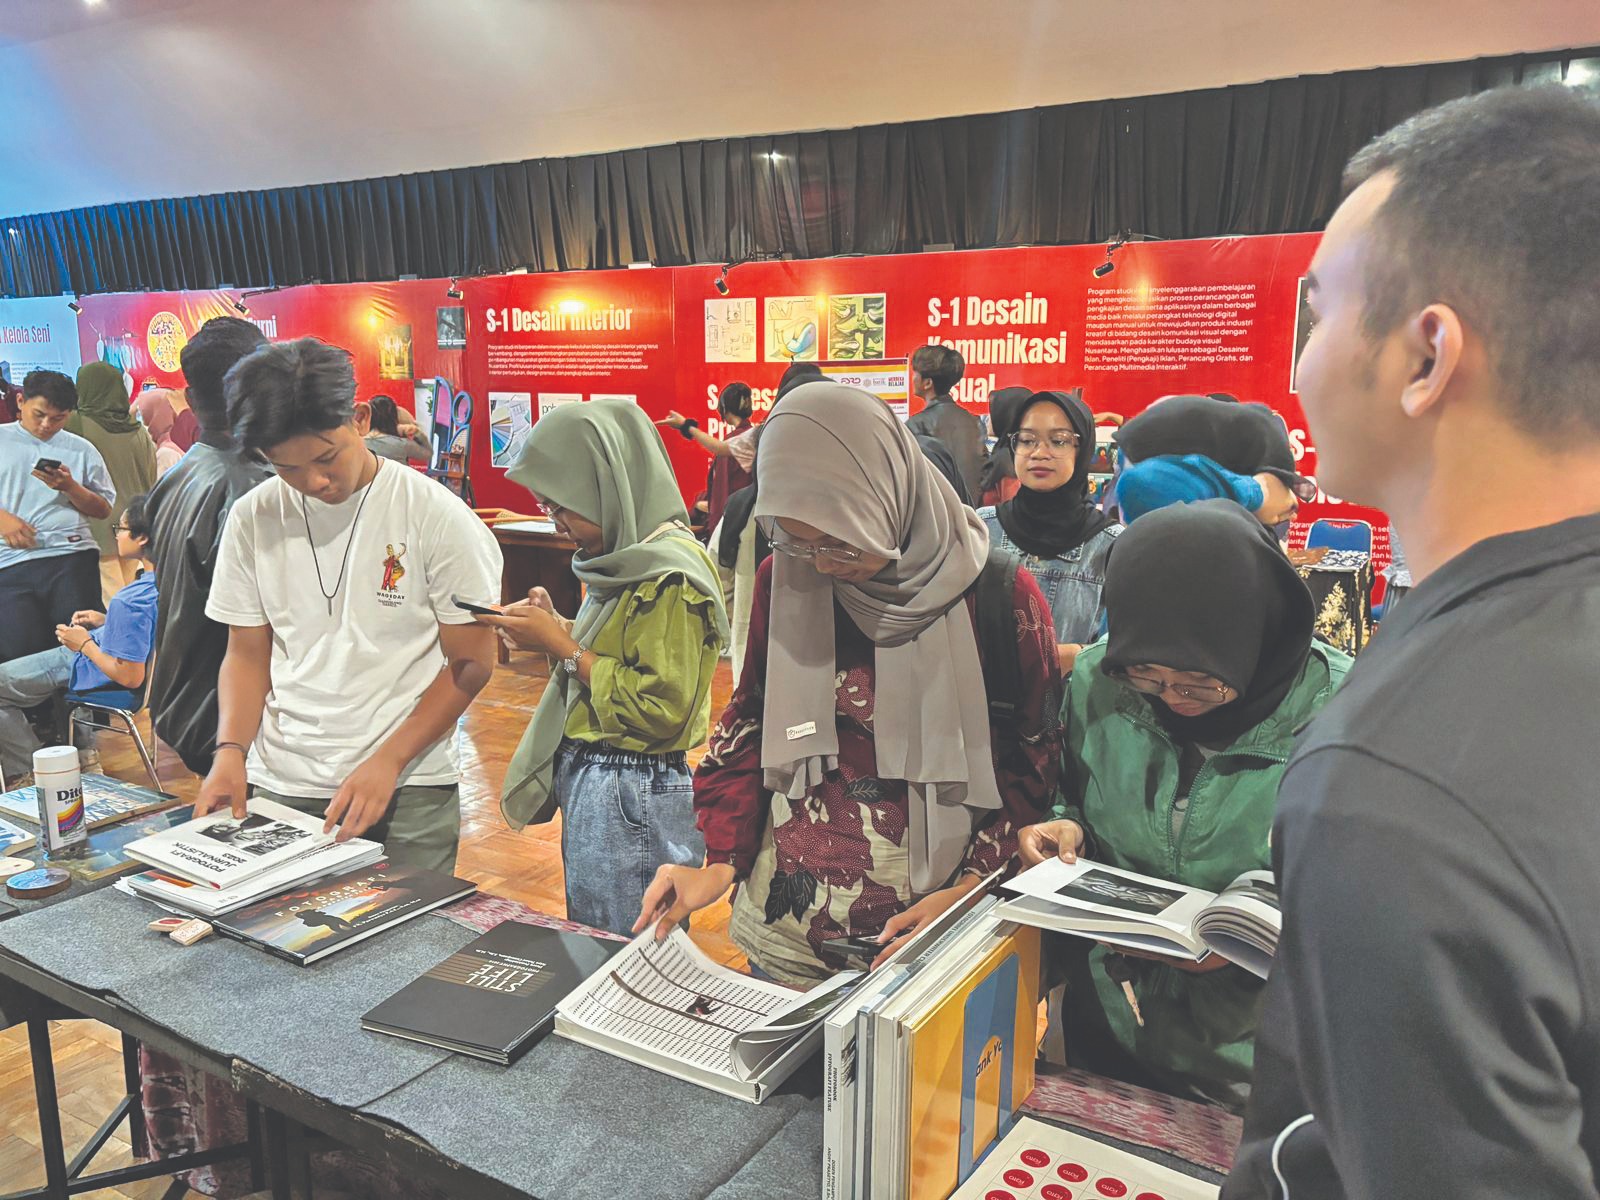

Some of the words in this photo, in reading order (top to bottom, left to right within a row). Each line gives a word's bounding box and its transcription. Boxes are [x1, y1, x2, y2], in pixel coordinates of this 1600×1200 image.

[486, 307, 509, 332] S-1
[512, 304, 566, 332] Desain
[928, 297, 960, 327] S-1
[966, 292, 1048, 326] Desain
[3, 326, 30, 344] Kelola
[31, 323, 51, 343] Seni
[170, 849, 226, 873] FOTOGRAFI
[172, 842, 238, 868] JURNALISTIK
[222, 852, 248, 864] 2023
[275, 873, 387, 918] FOTOGRAFI
[465, 973, 522, 993] STILL
[474, 964, 534, 984] LIFE
